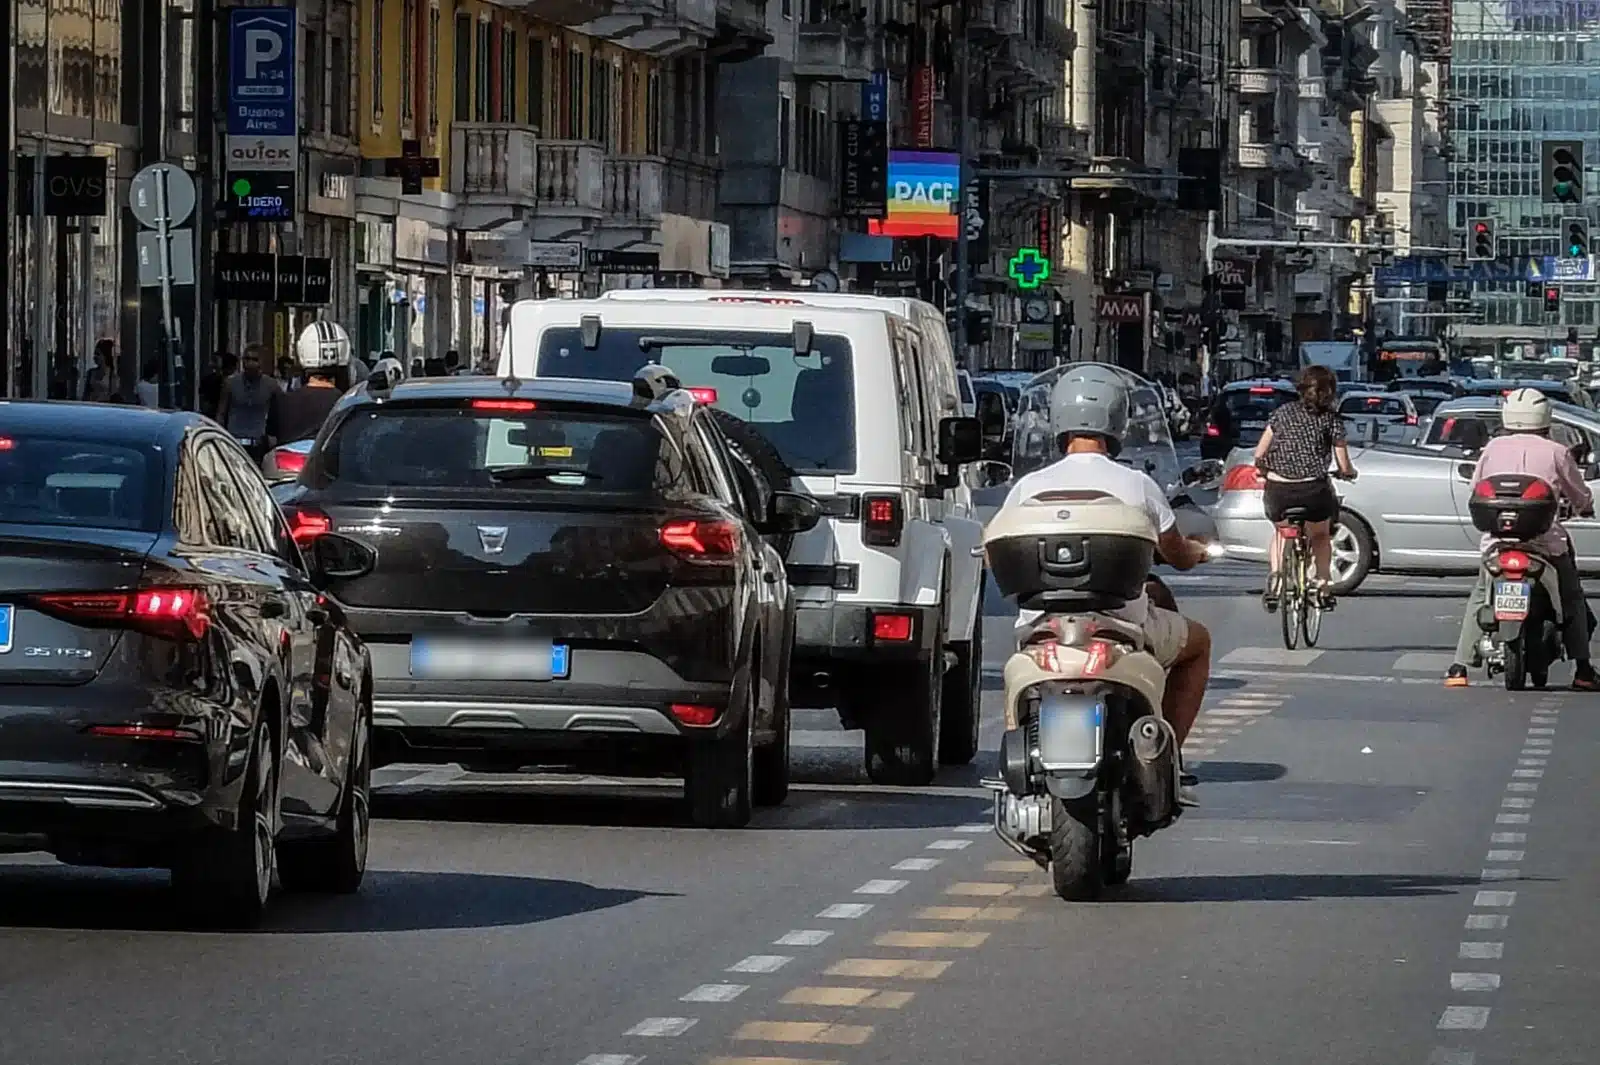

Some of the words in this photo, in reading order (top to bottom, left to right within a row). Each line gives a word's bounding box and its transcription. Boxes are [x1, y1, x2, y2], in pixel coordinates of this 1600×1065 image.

[244, 29, 283, 79] P
[238, 106, 285, 118] Buenos
[246, 119, 277, 129] Aires
[232, 145, 291, 159] QUICK
[50, 176, 104, 197] OVS
[894, 181, 954, 205] PACE
[221, 270, 271, 282] MANGO
